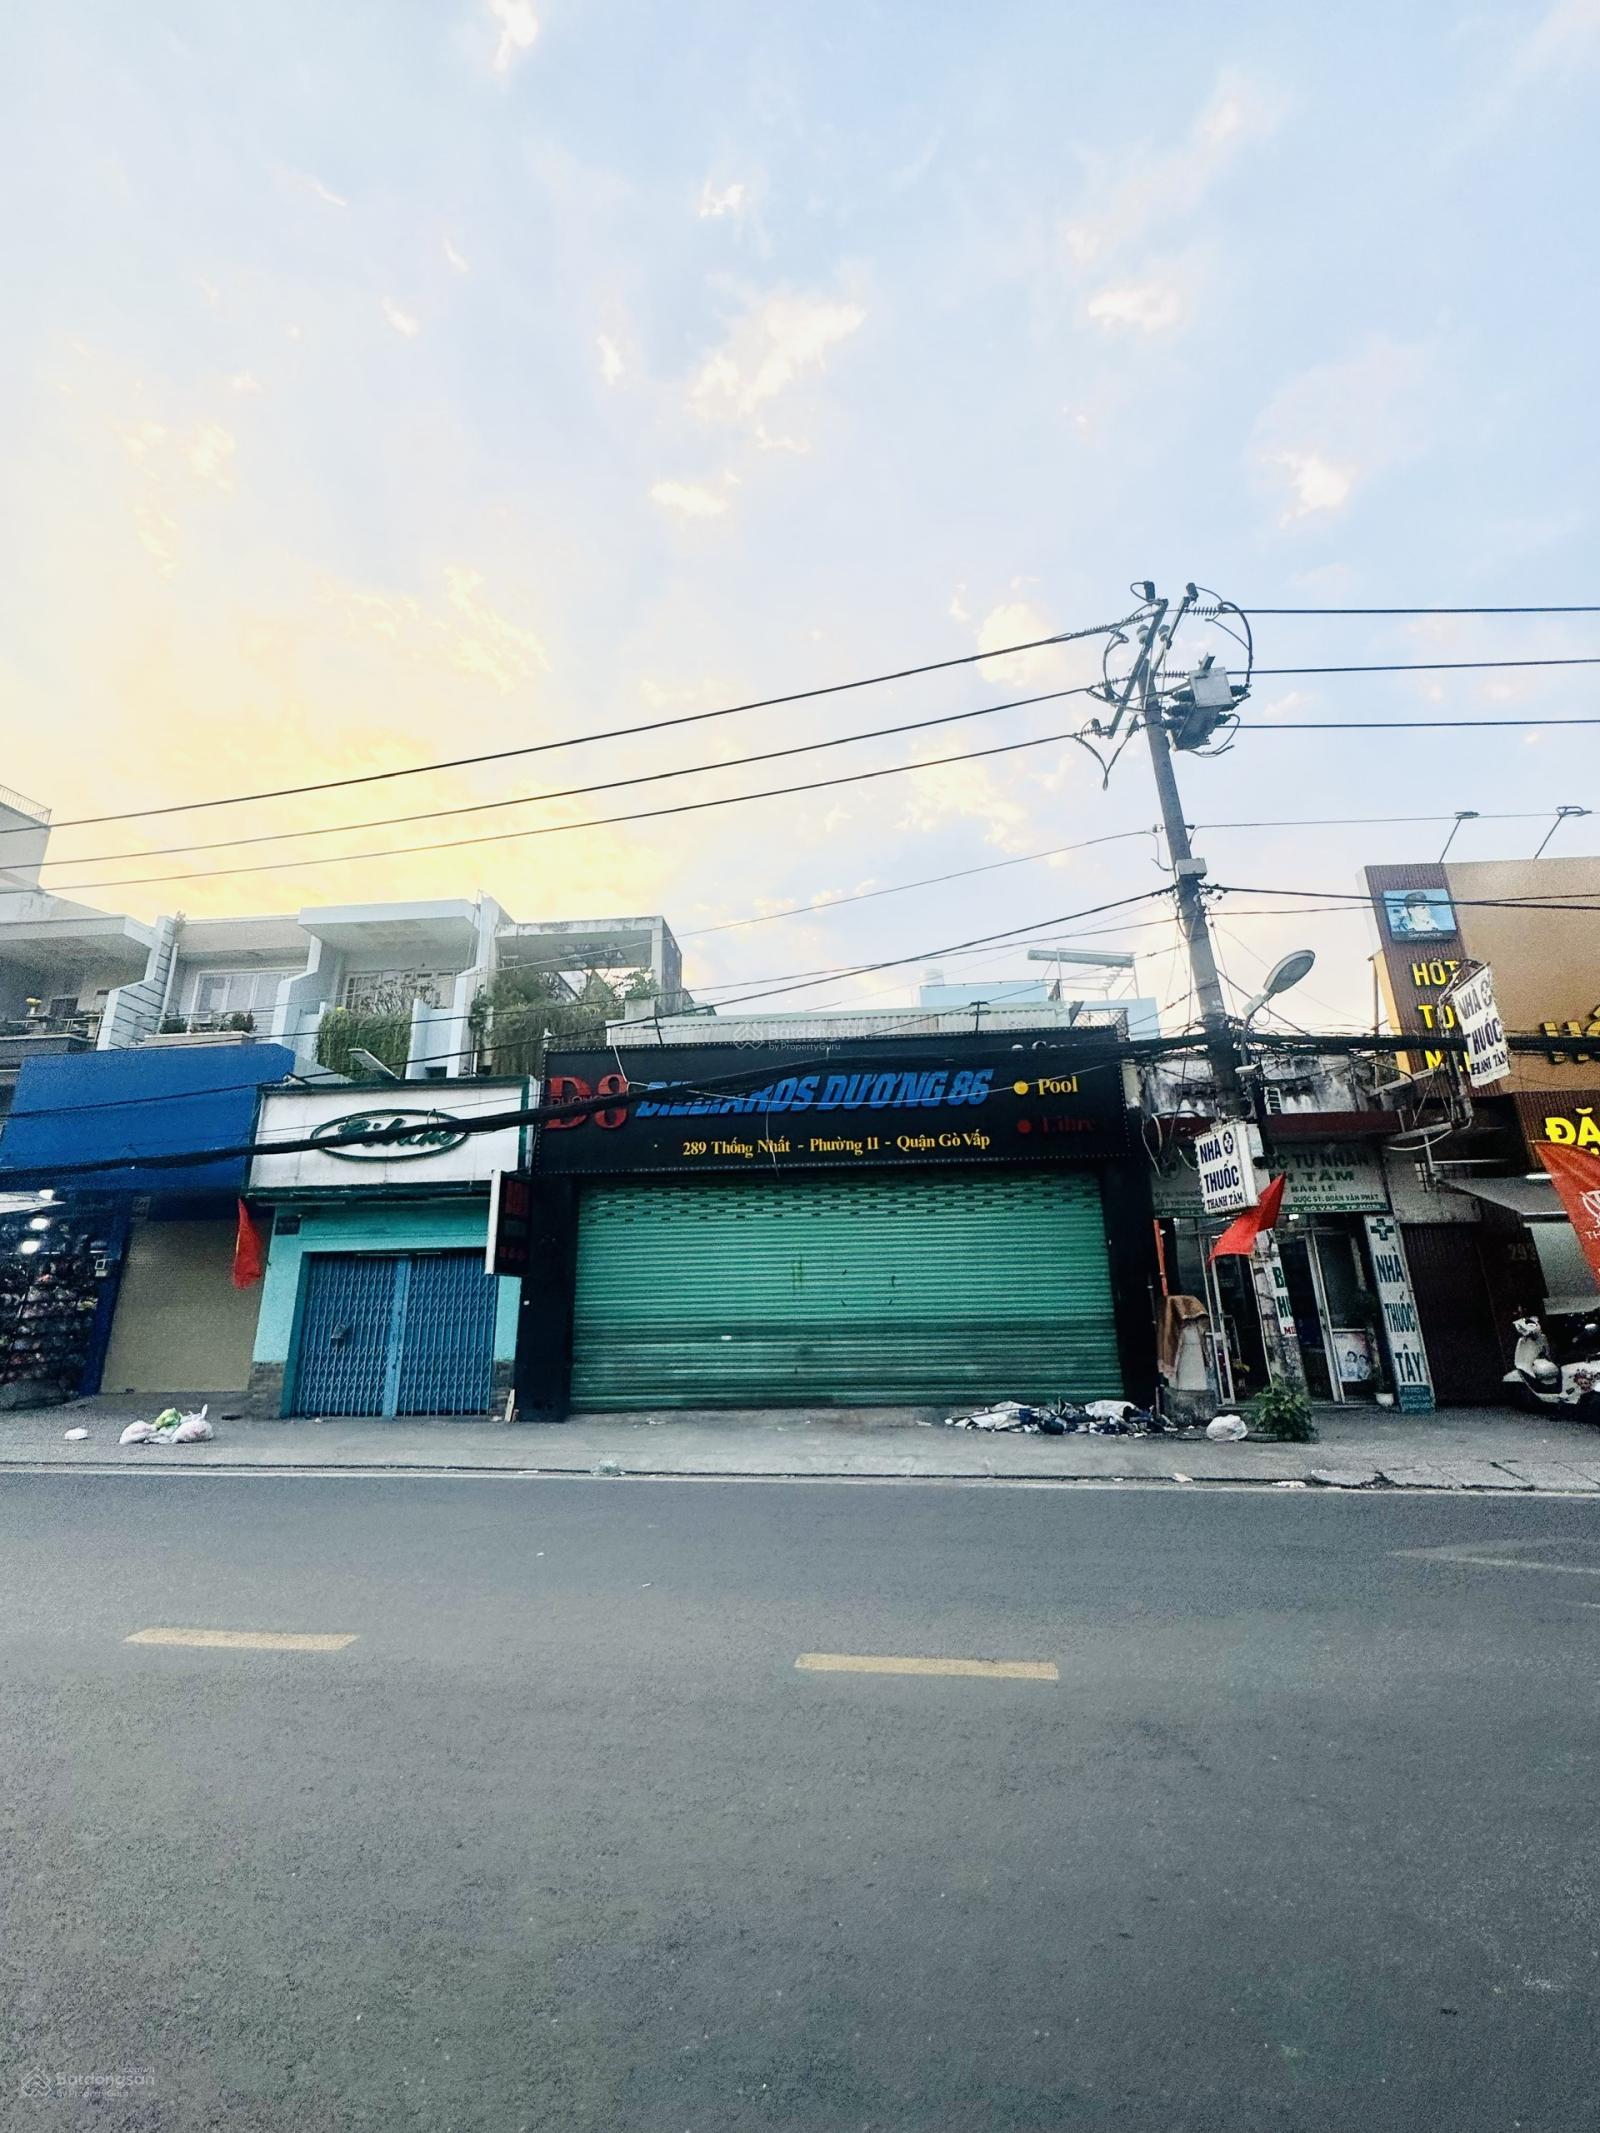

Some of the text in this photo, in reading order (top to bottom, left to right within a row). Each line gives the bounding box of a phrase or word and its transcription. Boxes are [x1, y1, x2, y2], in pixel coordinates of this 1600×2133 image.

[816, 1070, 950, 1111] DƯƠNG
[948, 1068, 995, 1106] 86
[1038, 1076, 1078, 1095] Pool
[682, 1141, 707, 1156] 289
[710, 1136, 754, 1159] Thống
[757, 1135, 791, 1153] Nhất
[810, 1136, 862, 1157] Phường
[867, 1136, 879, 1150] 11
[896, 1134, 936, 1152] Quận
[938, 1132, 961, 1148] Gò
[962, 1128, 991, 1150] Vấp
[1199, 1135, 1222, 1164] NHÀ
[1203, 1160, 1240, 1194] THUỐC
[1207, 1195, 1229, 1210] THANH
[1228, 1191, 1245, 1206] TÂM
[1375, 1246, 1405, 1283] NHÀ
[1384, 1291, 1417, 1333] THUỐC
[1394, 1343, 1424, 1383] TÂY
